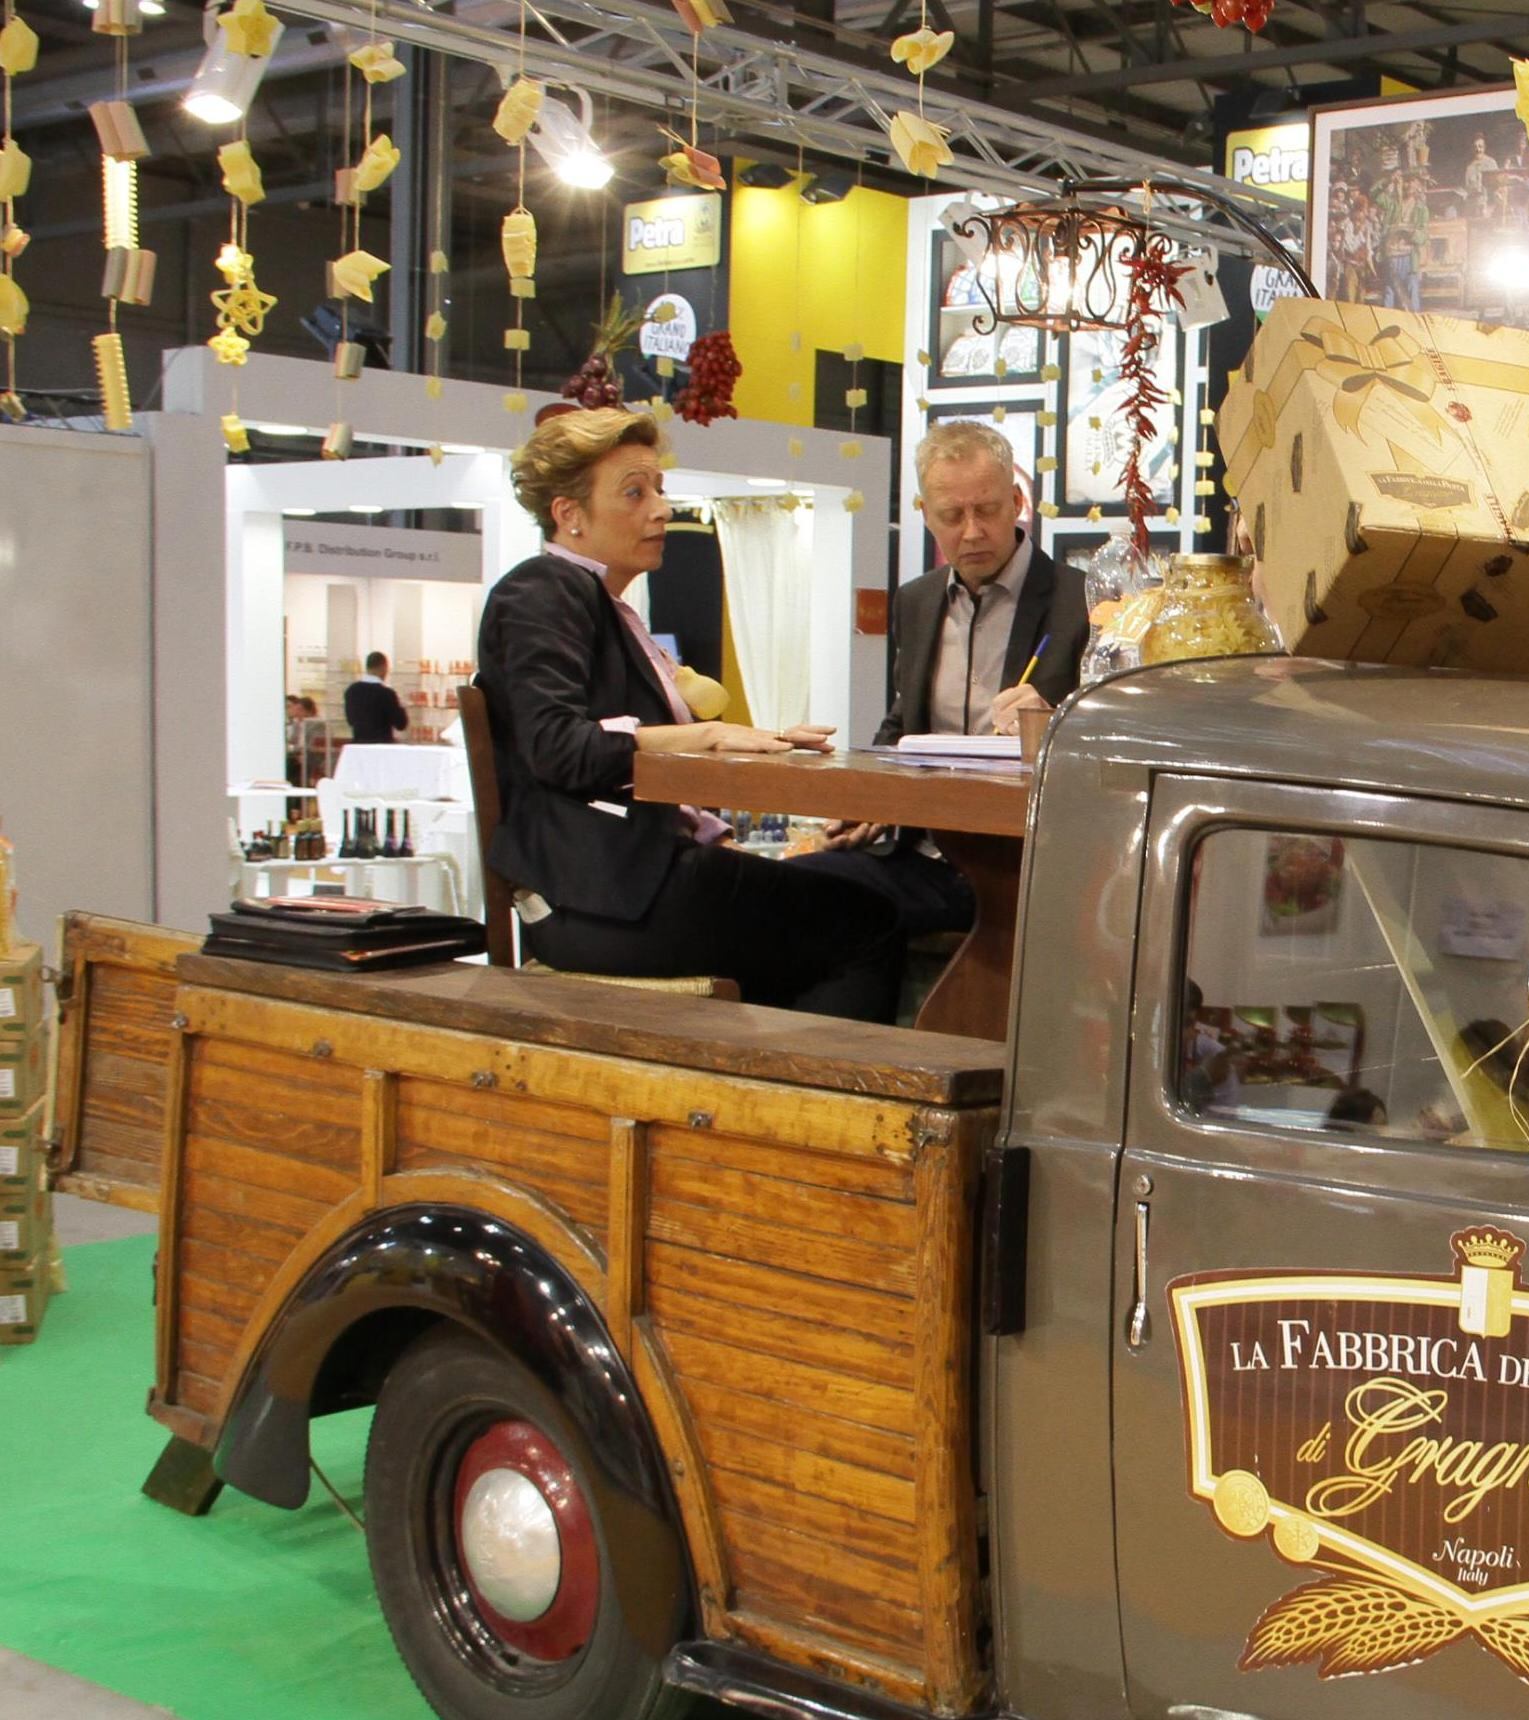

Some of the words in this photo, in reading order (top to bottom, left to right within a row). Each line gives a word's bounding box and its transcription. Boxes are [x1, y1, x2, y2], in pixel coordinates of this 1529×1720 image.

[1233, 147, 1308, 184] Petra
[629, 217, 685, 251] Petra
[319, 543, 381, 558] Distribution
[384, 548, 416, 562] Group
[1231, 1341, 1270, 1371] LA
[1277, 1319, 1488, 1382] FABBRICA
[1296, 1421, 1331, 1463] di
[1432, 1537, 1514, 1570] Napoli
[1457, 1567, 1488, 1586] Italy
